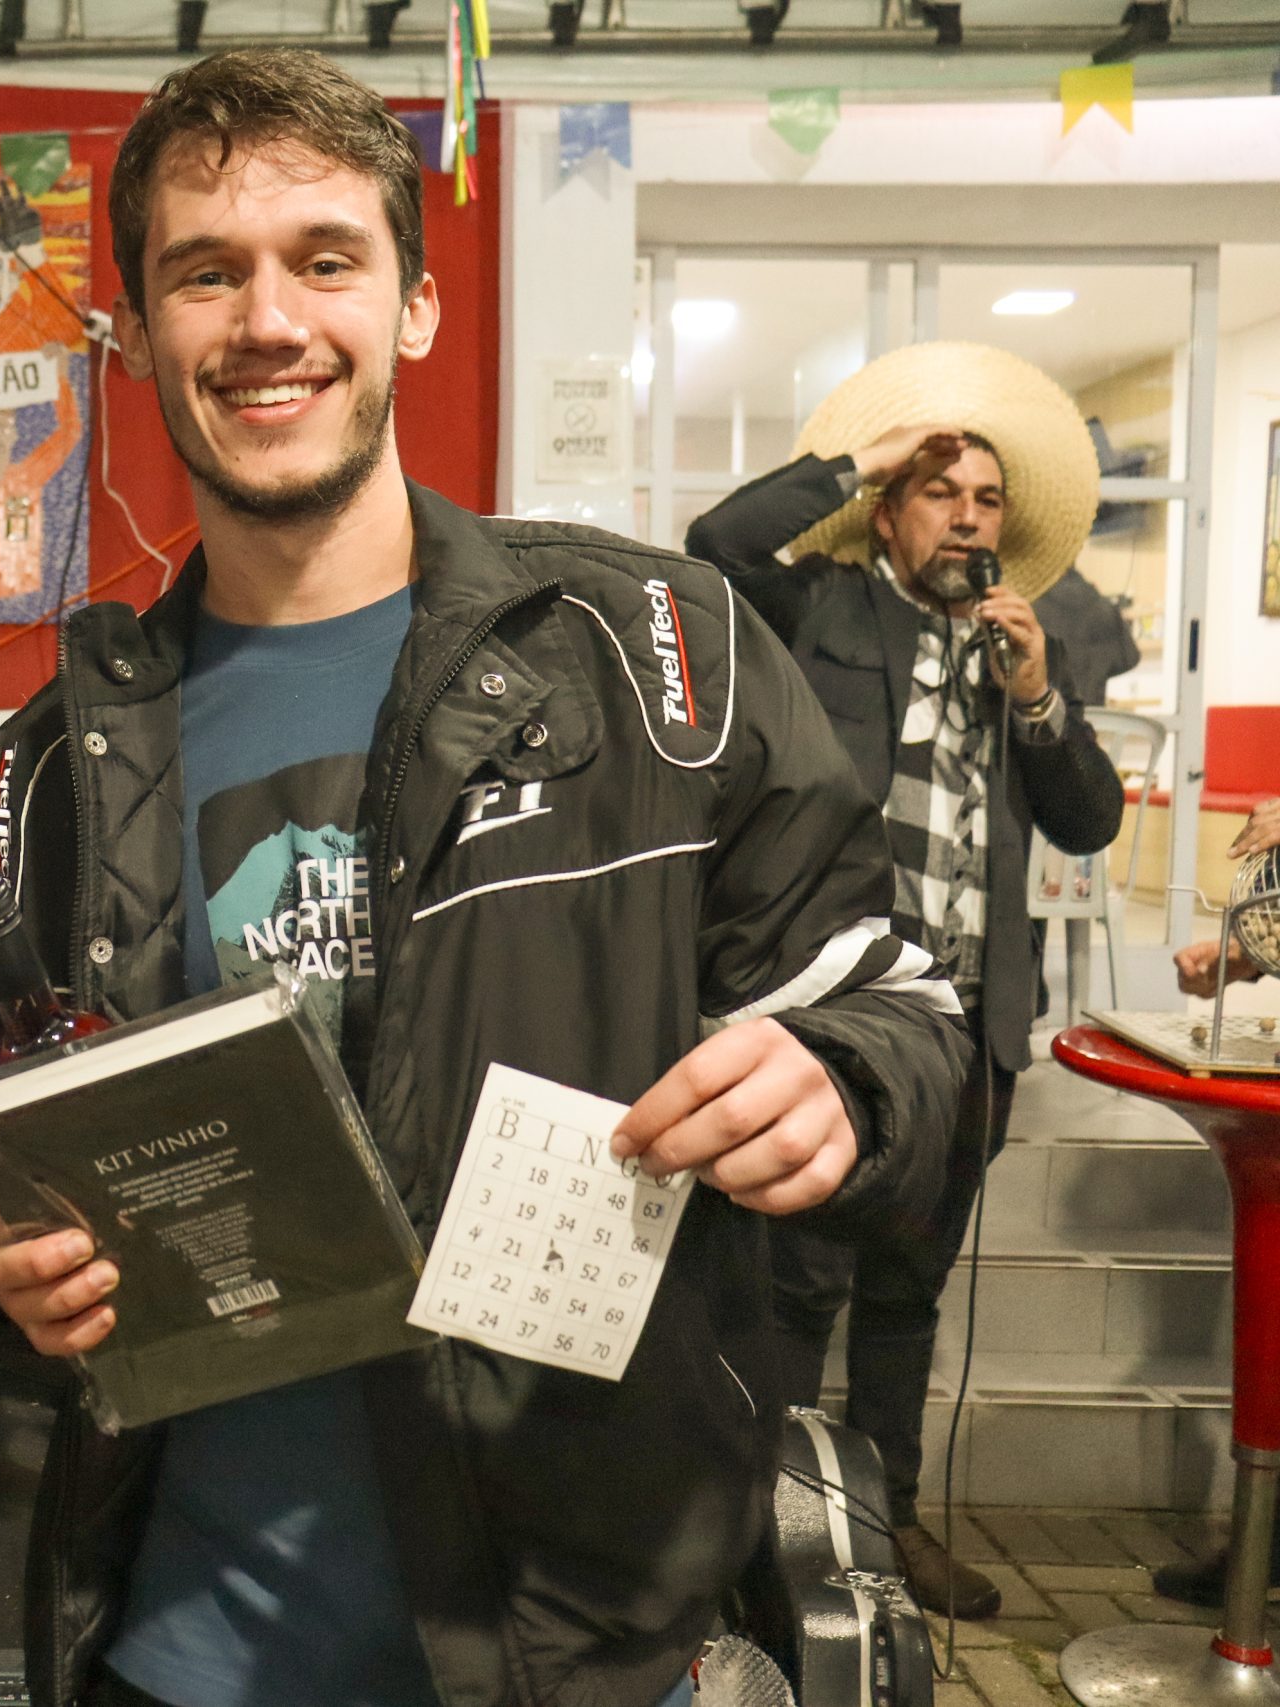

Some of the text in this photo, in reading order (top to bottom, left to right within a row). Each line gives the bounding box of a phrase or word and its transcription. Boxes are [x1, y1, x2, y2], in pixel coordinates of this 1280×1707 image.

[643, 578, 689, 725] FuelTech
[297, 857, 369, 899] THE
[242, 897, 372, 961] NORTH
[291, 936, 376, 980] ACE
[94, 1149, 133, 1175] KIT
[138, 1119, 228, 1158] VINHO
[492, 1153, 664, 1220] 2 18 33 48 63
[480, 1189, 651, 1255] 3 19 34 51 66
[469, 1227, 638, 1288] 4 21 52 67
[452, 1262, 625, 1323] 12 22 36 54 69
[440, 1299, 611, 1361] 14 24 37 56 70
